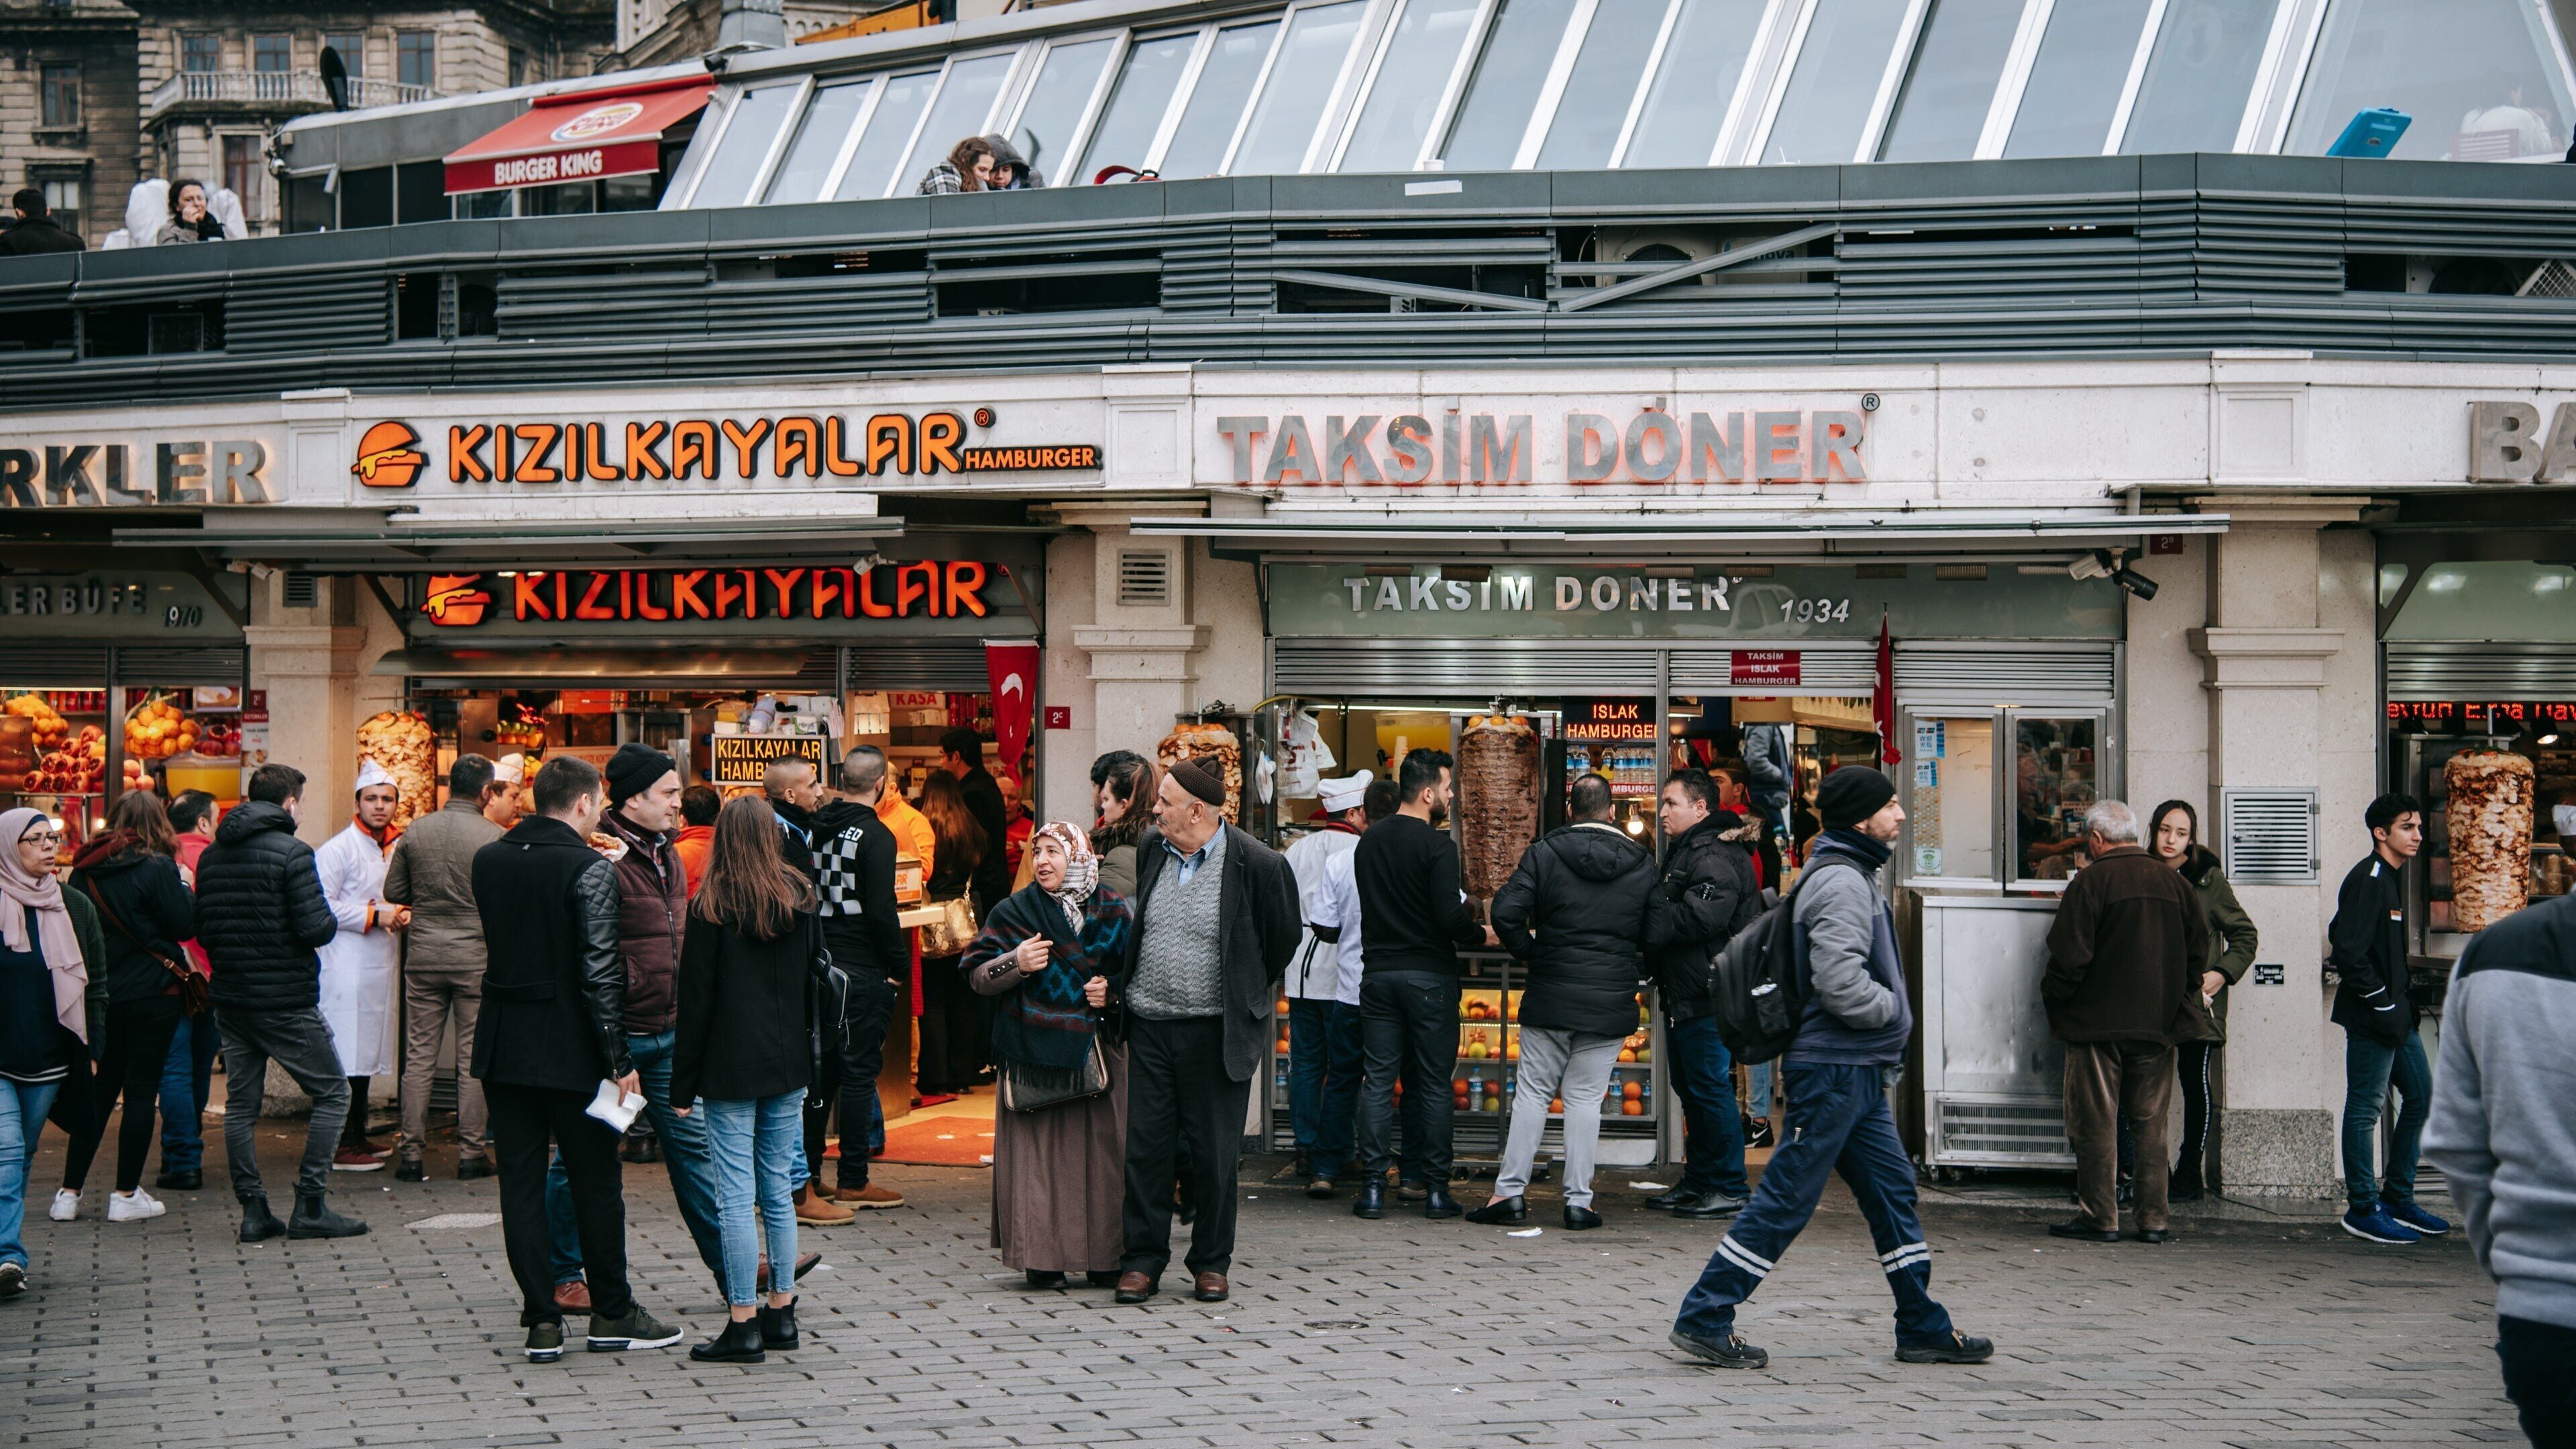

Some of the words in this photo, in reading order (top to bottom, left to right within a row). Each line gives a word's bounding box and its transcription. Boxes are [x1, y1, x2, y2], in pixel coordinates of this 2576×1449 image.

[494, 156, 557, 185] BURGER
[561, 150, 602, 177] KING
[449, 412, 967, 483] KIZILKAYALAR
[965, 447, 1095, 470] HAMBURGER
[1780, 598, 1849, 623] 1934
[1750, 664, 1780, 674] ISLAK
[1735, 677, 1796, 685] HAMBURGER
[896, 693, 938, 706] KASA
[1593, 704, 1638, 719] ISLAK
[1567, 723, 1658, 739] HAMBURGE
[721, 761, 818, 781] HAMBR
